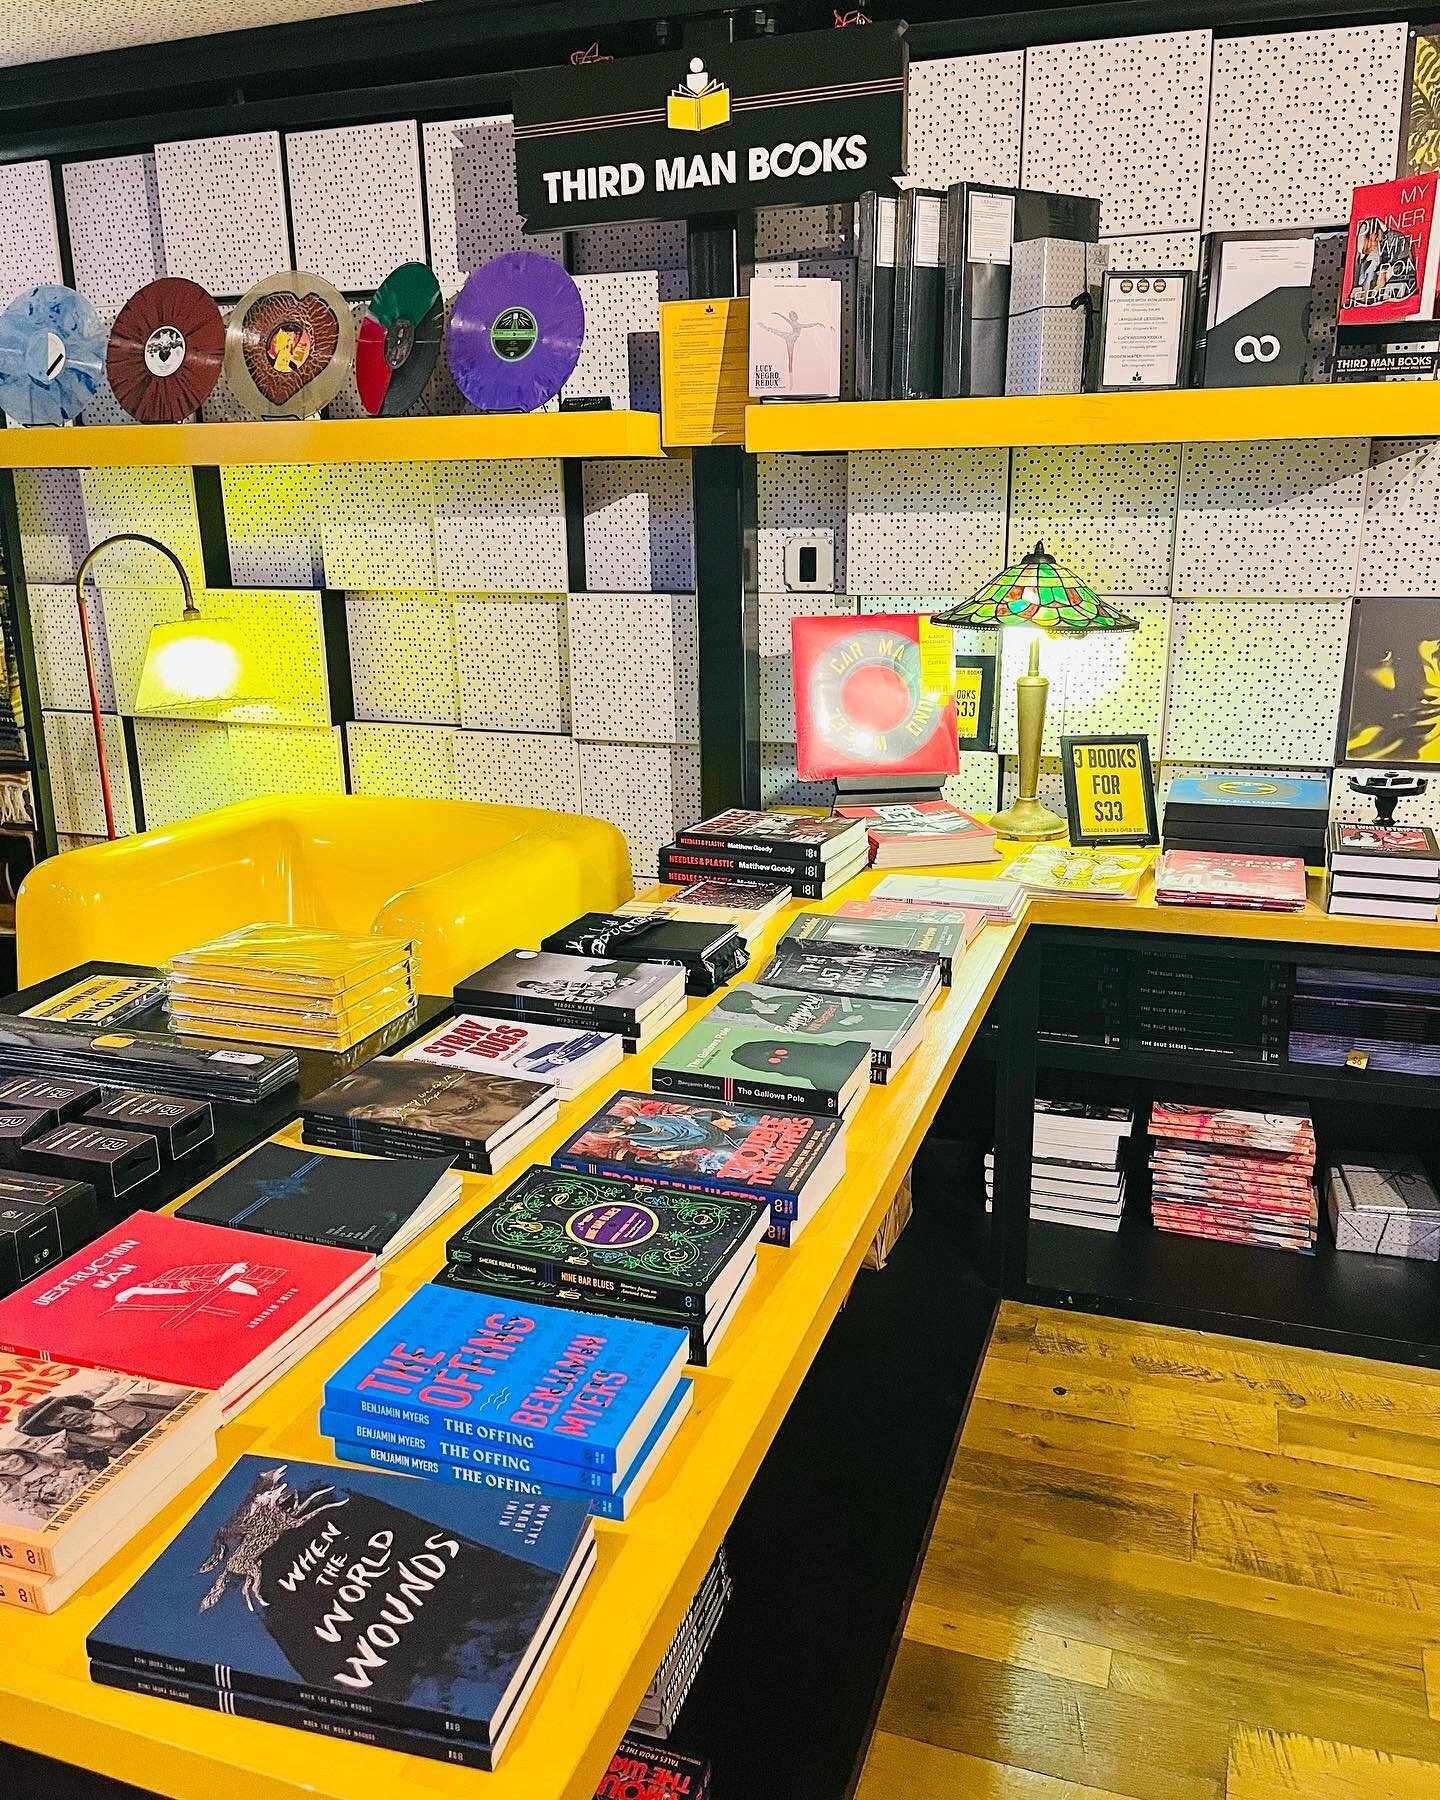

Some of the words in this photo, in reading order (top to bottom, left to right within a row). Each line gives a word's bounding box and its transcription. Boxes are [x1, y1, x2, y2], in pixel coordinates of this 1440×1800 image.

[543, 162, 645, 204] THIRD
[655, 150, 737, 192] MAN
[749, 134, 867, 182] BOOKS
[1400, 183, 1430, 205] MY
[1356, 208, 1425, 236] DINNER
[1378, 232, 1422, 259] WITH
[1379, 257, 1418, 277] RON
[1343, 282, 1418, 309] JEREMY
[755, 364, 773, 372] LUCY
[1337, 359, 1368, 368] THIRD
[1371, 358, 1394, 367] MAN
[1398, 356, 1432, 366] BOOKS
[755, 379, 779, 387] REDUX
[829, 642, 864, 674] CAR
[879, 638, 905, 660] MA
[956, 689, 976, 700] OOKS
[1074, 748, 1083, 768] 3
[1088, 748, 1137, 768] BOOKS
[1092, 775, 1121, 795] FOR
[1094, 800, 1124, 822] $33
[727, 842, 754, 851] Matthew
[753, 844, 773, 854] Goody
[669, 855, 699, 865] NEEDLES
[705, 859, 734, 868] PLASTIC
[739, 861, 772, 872] Matthew
[772, 862, 796, 875] Goody
[71, 982, 150, 1020] PANTONE
[577, 1004, 596, 1012] WATER
[423, 1019, 493, 1058] STRAY
[465, 1024, 529, 1059] DOGS
[687, 1056, 702, 1068] The
[698, 1036, 722, 1062] Gallows
[714, 1026, 732, 1045] Pole
[677, 1079, 703, 1088] Benjamin
[703, 1083, 721, 1091] Myers
[738, 1087, 753, 1096] The
[754, 1089, 785, 1101] Gallows
[787, 1092, 805, 1103] Pole
[32, 1239, 141, 1306] DESTRUCTION
[91, 1263, 138, 1289] MAN
[515, 1264, 537, 1274] THOMAS
[561, 1271, 577, 1283] NINE
[578, 1274, 592, 1286] BAR
[592, 1277, 615, 1291] BLUES
[355, 1343, 446, 1395] THE
[417, 1312, 536, 1410] OFFING
[509, 1333, 608, 1428] BENJAMIN
[553, 1371, 629, 1438] MYERS
[361, 1400, 401, 1421] BENJAMIN
[402, 1410, 430, 1426] MYERS
[443, 1418, 474, 1436] THE
[476, 1423, 535, 1449] OFFING
[356, 1425, 397, 1446] BENJAMIN
[398, 1434, 426, 1450] MYERS
[439, 1442, 470, 1460] THE
[472, 1449, 531, 1472] OFFING
[370, 1448, 410, 1468] BENJAMIN
[411, 1457, 439, 1475] MYERS
[452, 1466, 482, 1485] THE
[484, 1472, 542, 1496] OFFING
[499, 1500, 520, 1526] KIINI
[512, 1503, 536, 1533] IBURA
[524, 1504, 551, 1545] SALAAM
[278, 1522, 339, 1592] WHEN
[316, 1542, 350, 1588] THE
[314, 1529, 395, 1643] WORLD
[333, 1532, 461, 1689] WOUNDS
[626, 1745, 639, 1756] THE
[638, 1750, 659, 1762] FROM
[660, 1755, 679, 1767] TALES
[651, 1767, 692, 1796] THE
